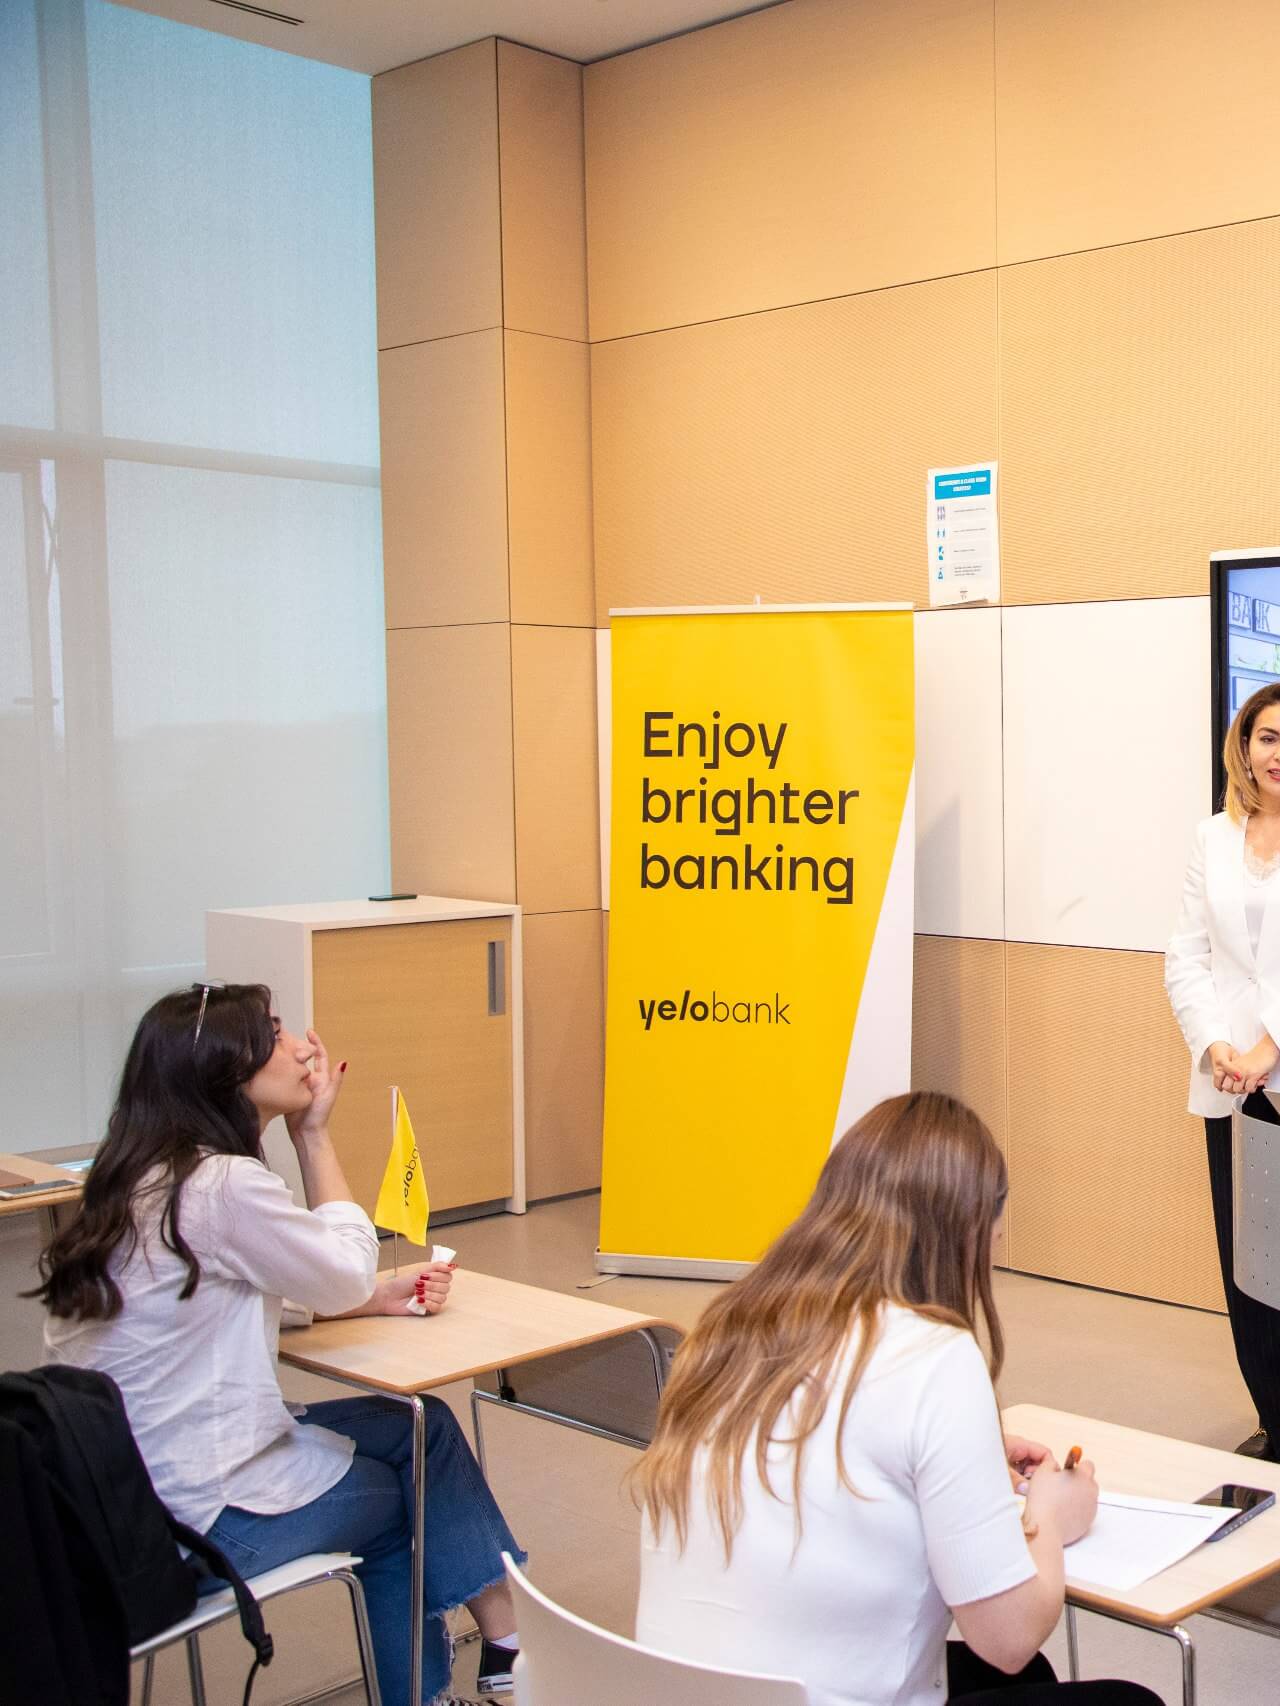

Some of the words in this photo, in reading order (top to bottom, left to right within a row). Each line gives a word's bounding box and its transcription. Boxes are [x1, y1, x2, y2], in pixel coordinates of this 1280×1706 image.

[643, 710, 788, 770] Enjoy
[642, 776, 860, 836] brighter
[640, 842, 854, 905] banking
[638, 989, 791, 1031] yelobank
